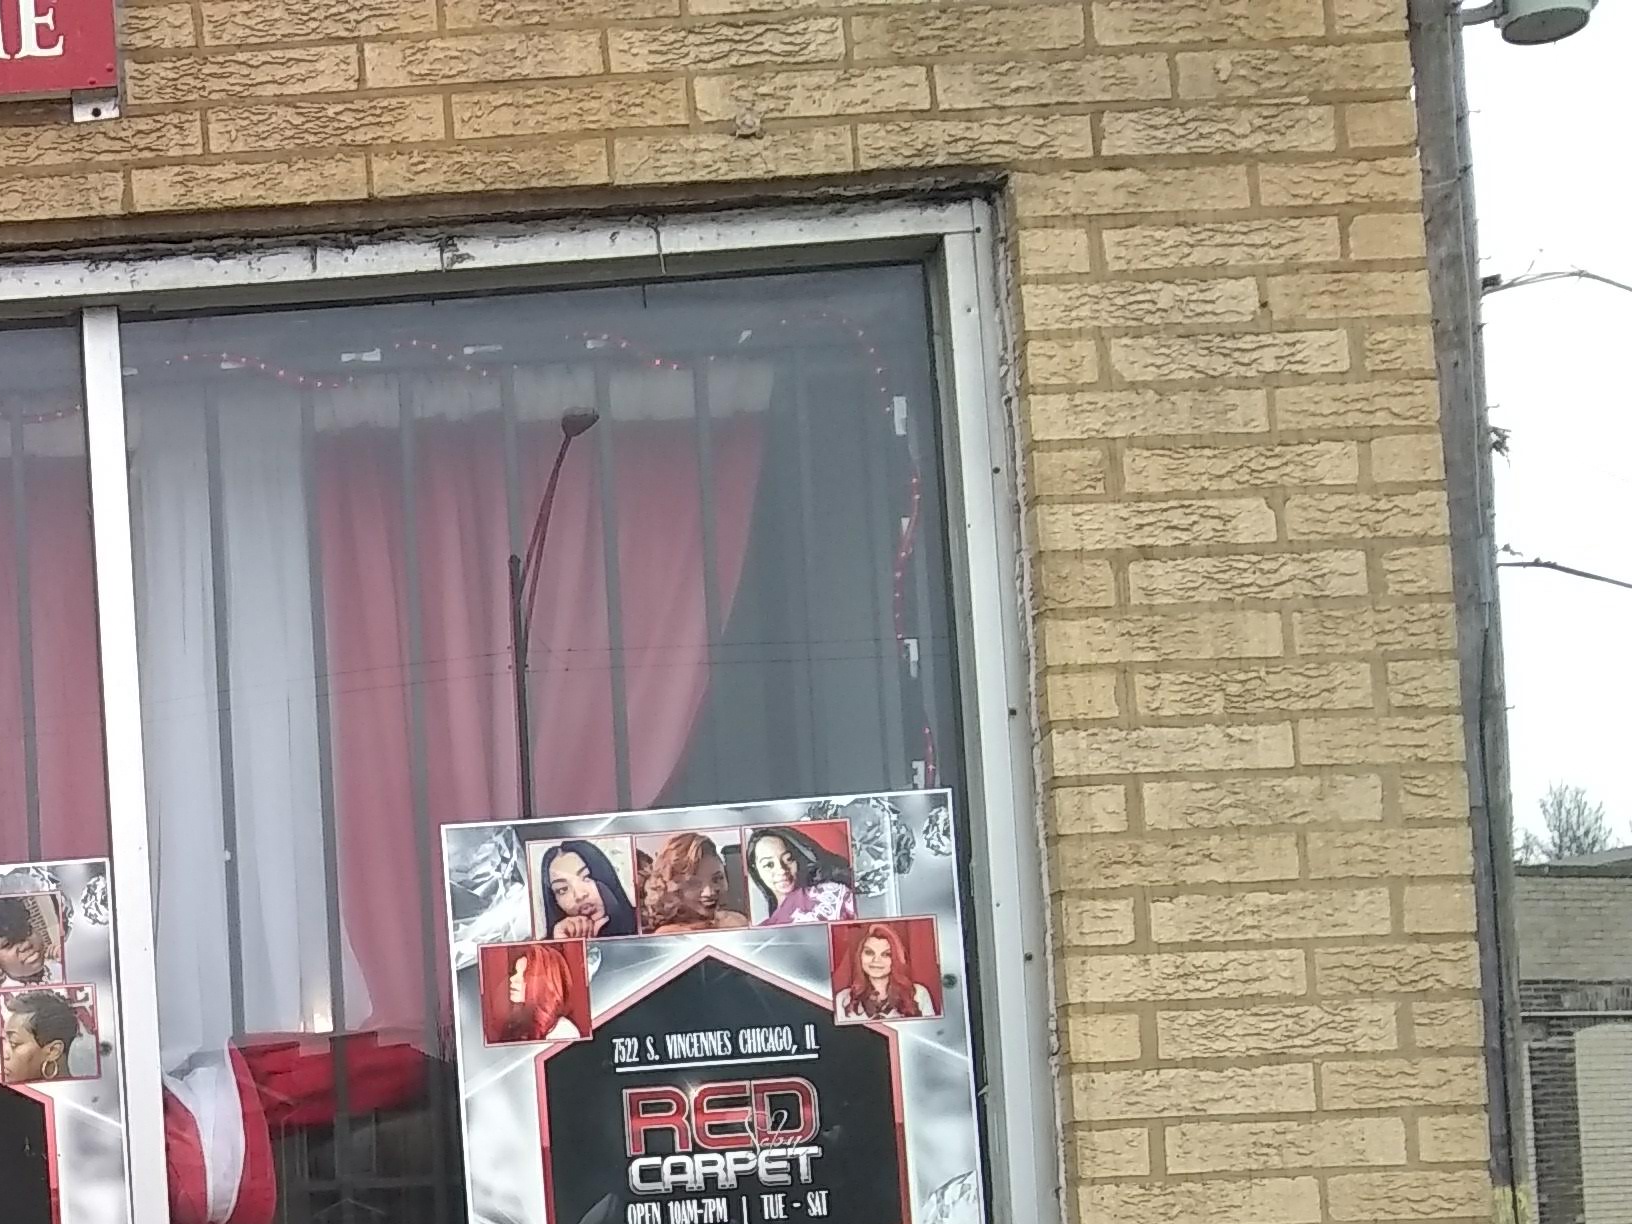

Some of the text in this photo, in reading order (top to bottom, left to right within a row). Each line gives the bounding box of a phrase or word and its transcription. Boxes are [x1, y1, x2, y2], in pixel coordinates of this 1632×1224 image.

[612, 1024, 819, 1063] 7522 S. VINCENNES CHICAGO, IL
[622, 1076, 821, 1157] RED
[626, 1146, 823, 1195] CARPET
[760, 1193, 788, 1220] TUE
[806, 1190, 828, 1217] SAT
